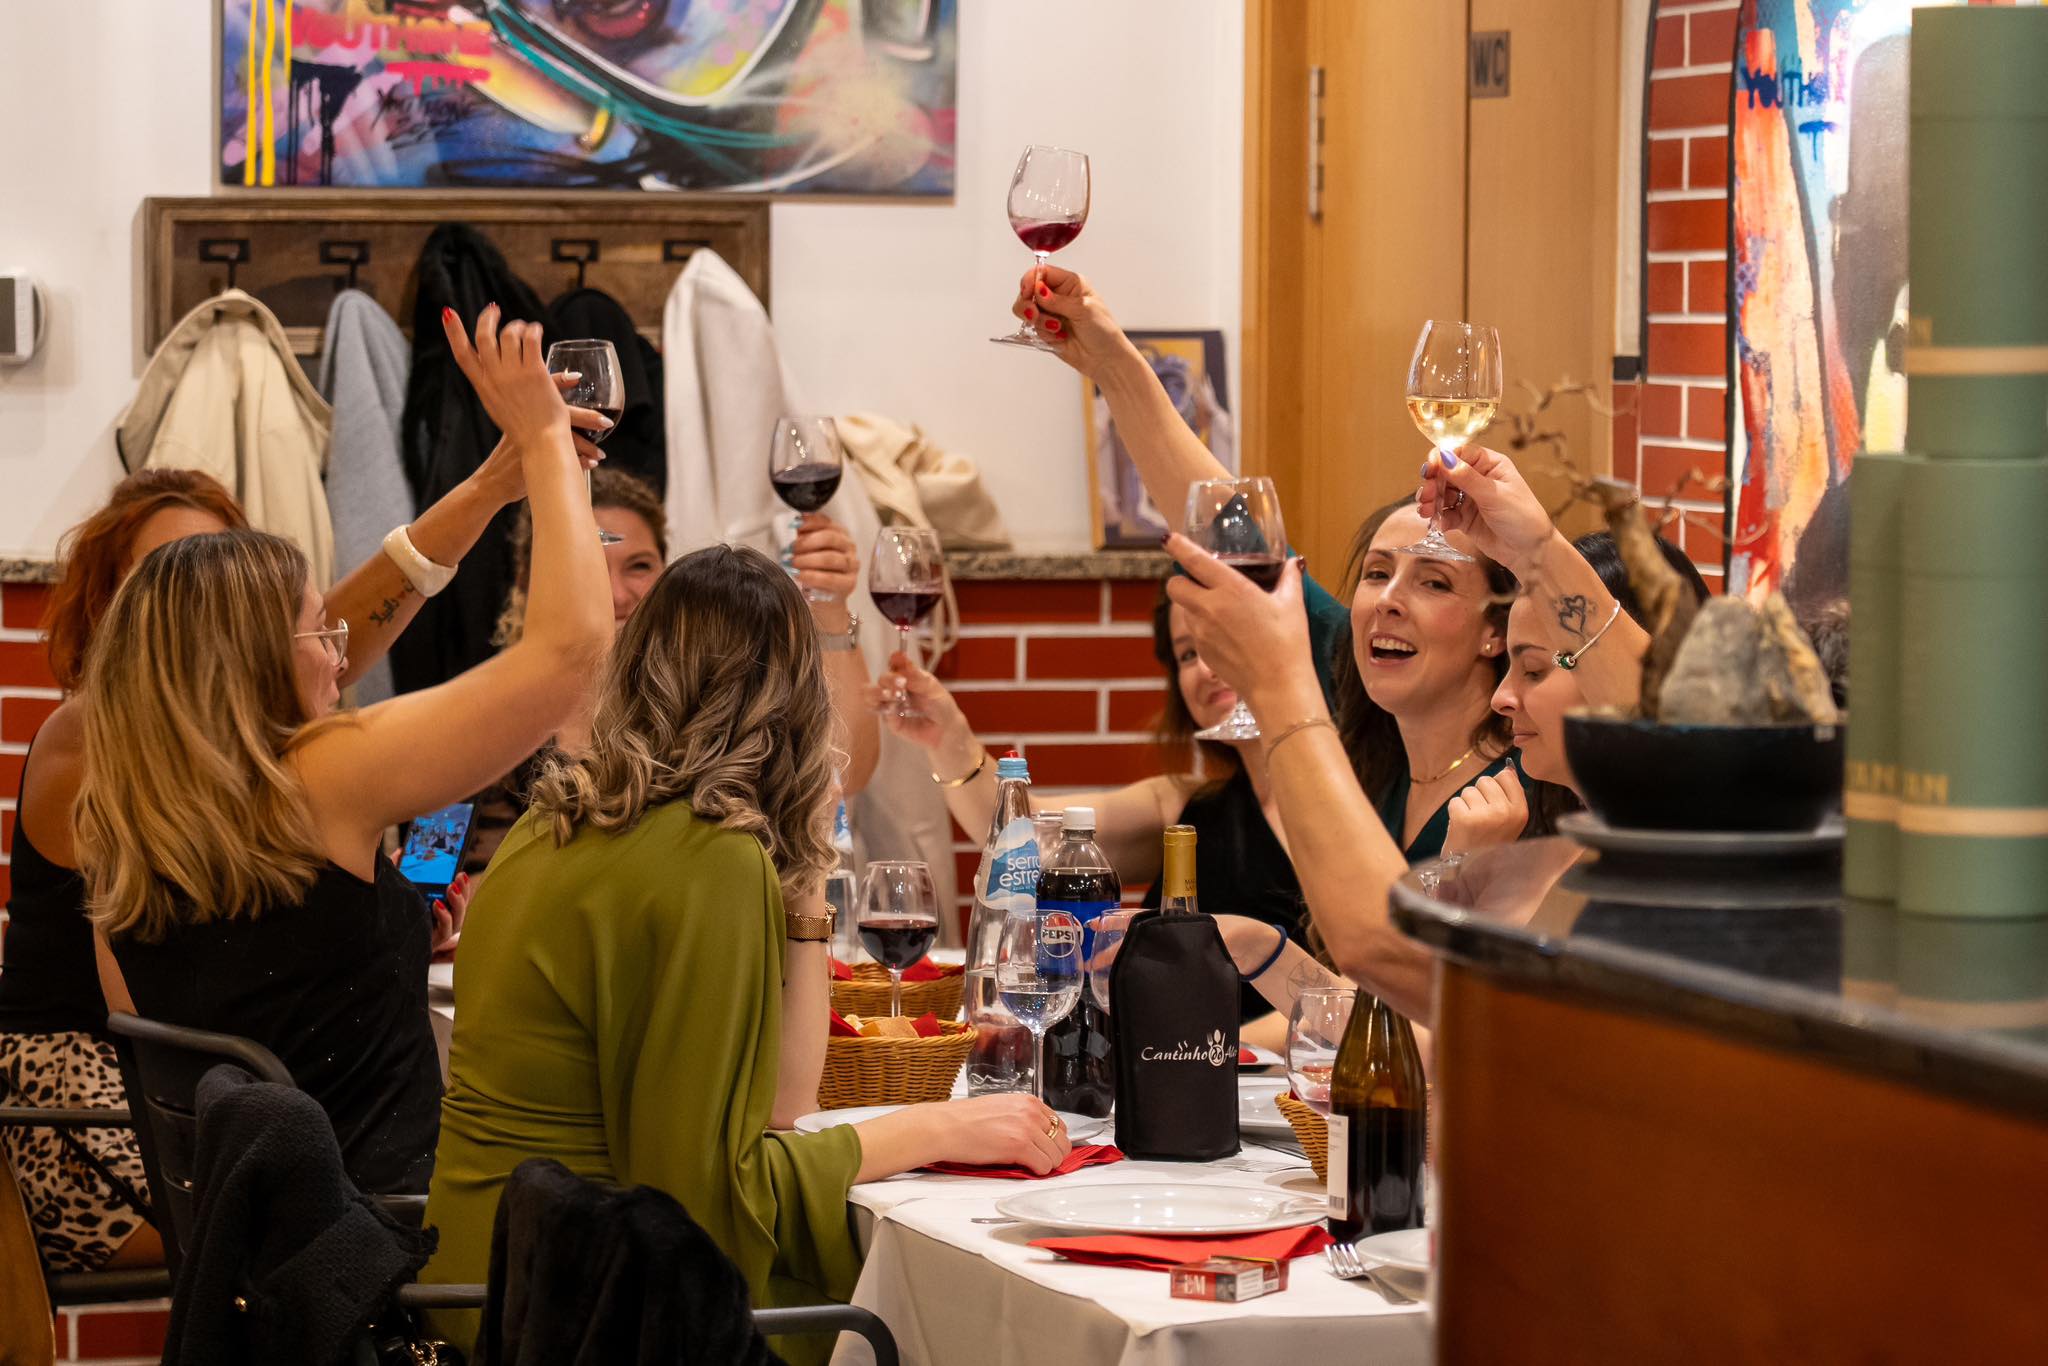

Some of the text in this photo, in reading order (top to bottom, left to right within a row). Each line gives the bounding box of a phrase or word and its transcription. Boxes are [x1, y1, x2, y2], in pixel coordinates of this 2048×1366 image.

[1473, 38, 1505, 88] WC
[1042, 929, 1081, 940] PEPSI
[1141, 1042, 1208, 1061] Cantinho
